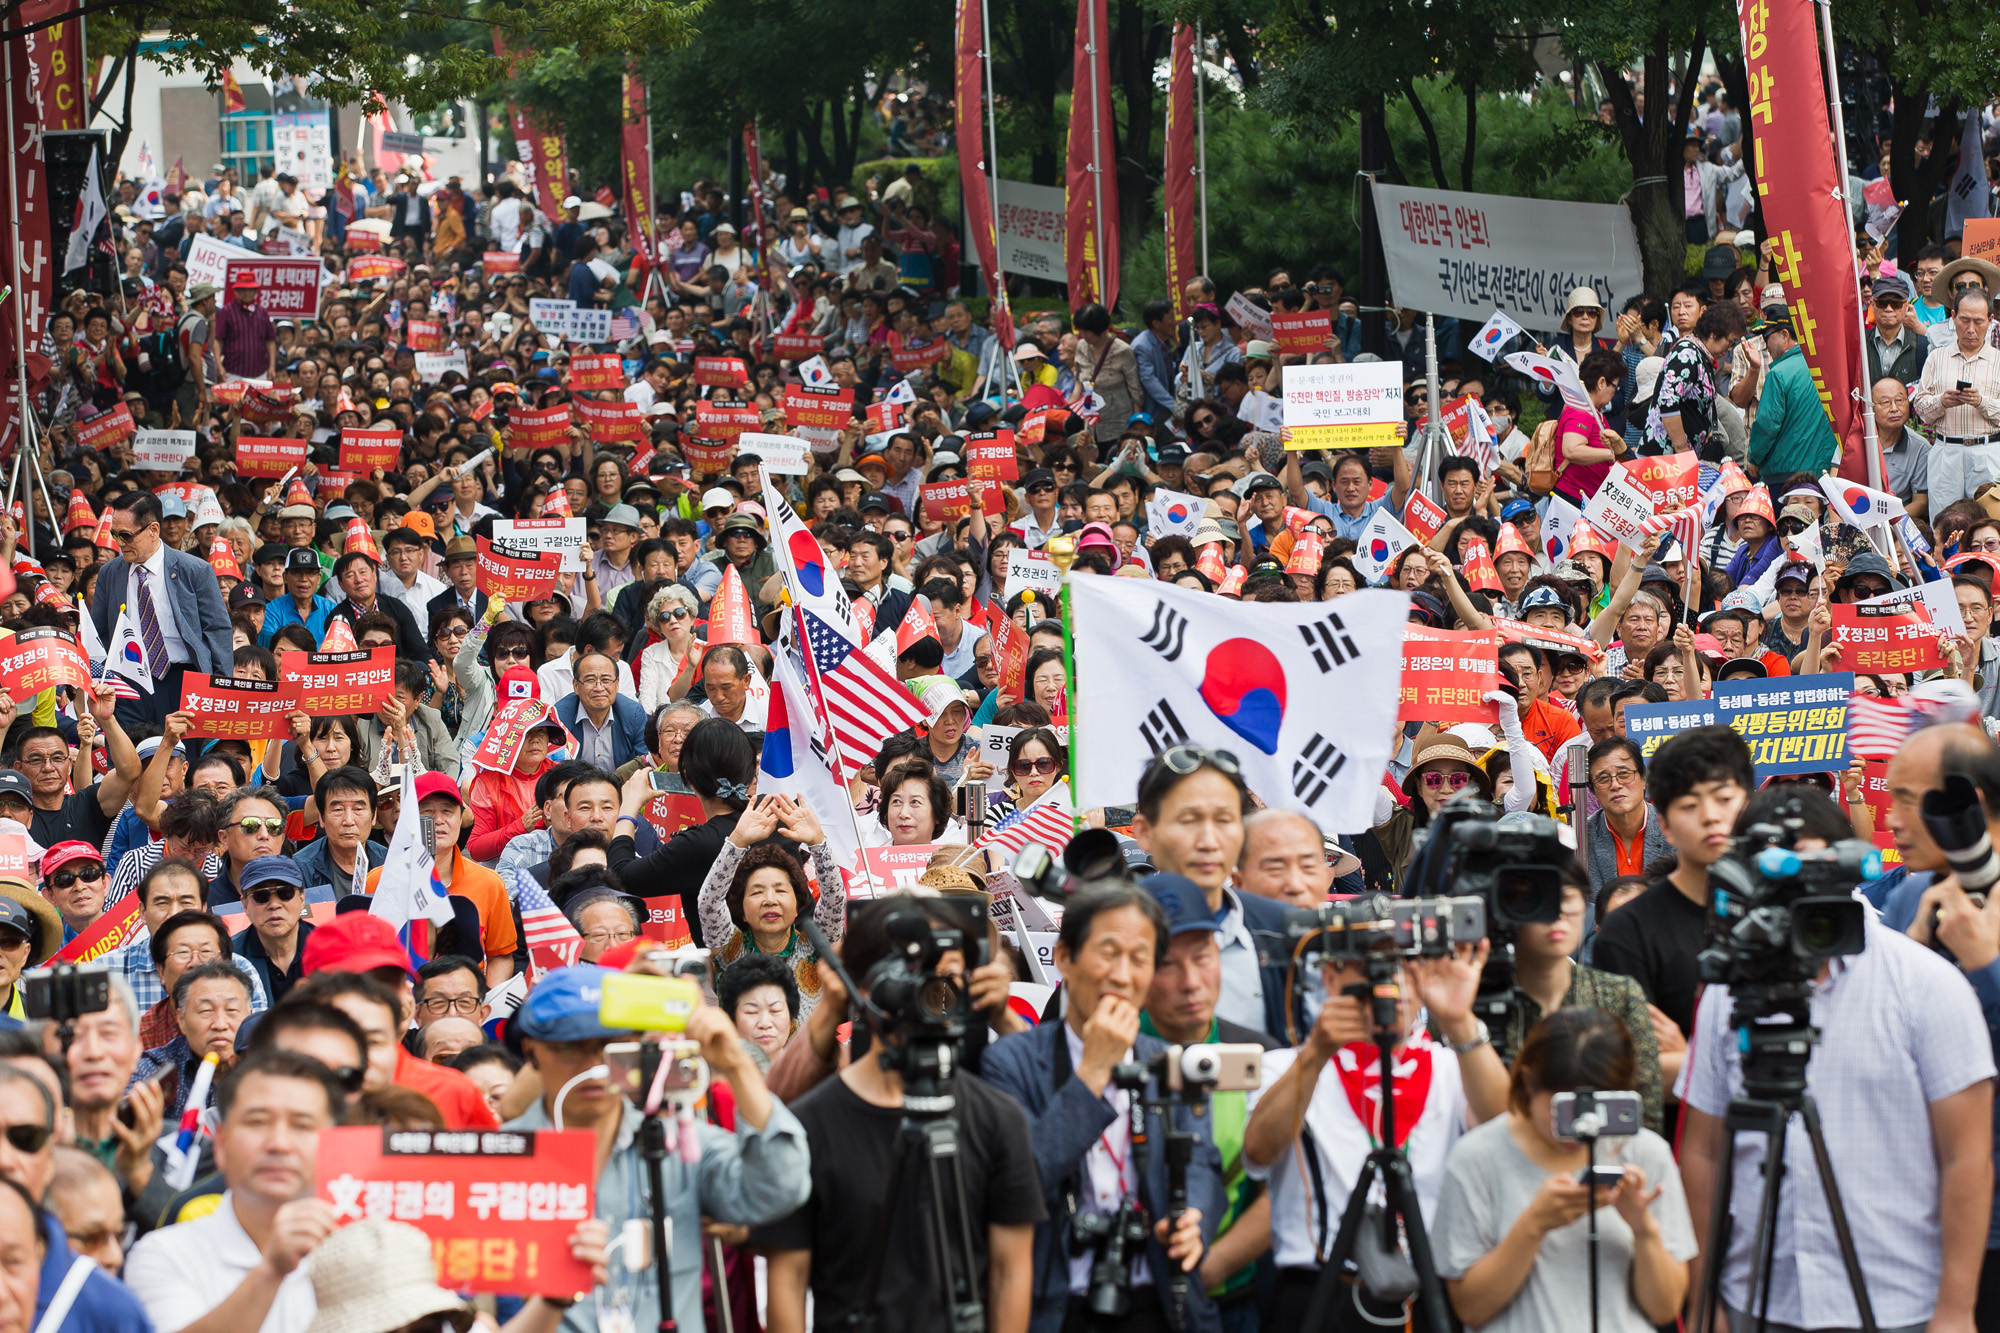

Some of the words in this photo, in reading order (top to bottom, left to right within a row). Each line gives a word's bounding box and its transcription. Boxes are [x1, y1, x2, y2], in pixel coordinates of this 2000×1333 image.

[1399, 199, 1454, 249] 대한민국
[1454, 205, 1491, 250] 안보!
[1438, 257, 1547, 316] 국가안보전략단이
[1312, 408, 1331, 418] 국민
[1334, 406, 1371, 417] 보고대회
[979, 446, 1013, 459] 구걸안보
[1602, 480, 1634, 511] 文정권의
[424, 522, 432, 532] S
[543, 535, 583, 548] 구걸안보
[478, 551, 510, 578] 文정권의
[514, 567, 556, 580] 구걸안보
[1011, 564, 1049, 580] 文정권의
[995, 614, 1011, 651] 구걸안보
[1836, 624, 1889, 643] 文정권의
[1, 646, 49, 676] 文정권의
[312, 654, 329, 662] 5천만
[331, 653, 348, 662] 핵인질
[350, 651, 367, 660] 만드는
[1410, 656, 1454, 671] 김정은의
[1458, 657, 1496, 674] 핵개발을
[214, 678, 232, 687] 5천만
[233, 680, 253, 689] 핵인질
[254, 682, 274, 690] 만드는
[285, 671, 338, 689] 文정권의
[344, 667, 392, 687] 구걸안보
[185, 693, 240, 713] 文정권의
[246, 698, 297, 714] 구걸안보
[1793, 687, 1850, 706] 합법화하는
[504, 730, 520, 748] 북구
[496, 747, 513, 766] 부산
[327, 1174, 456, 1220] 文정권의
[466, 1182, 588, 1221] 구걸안보
